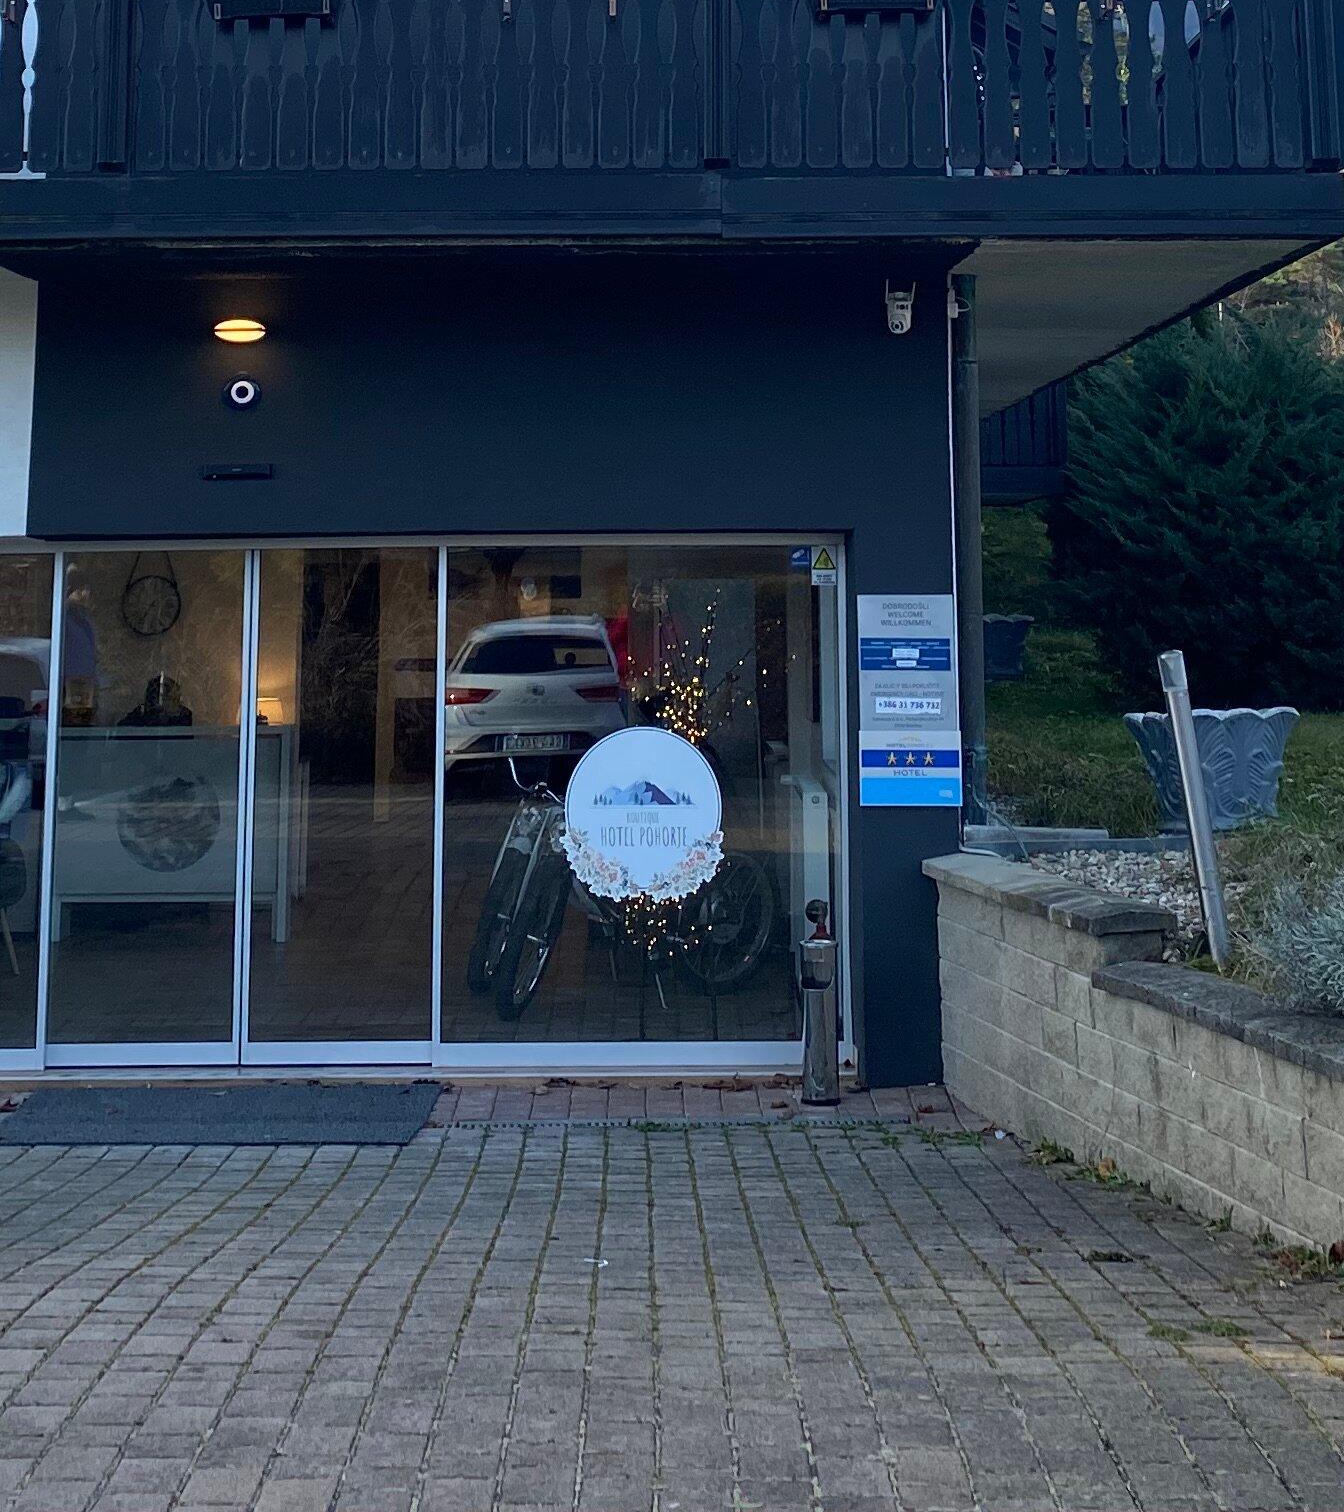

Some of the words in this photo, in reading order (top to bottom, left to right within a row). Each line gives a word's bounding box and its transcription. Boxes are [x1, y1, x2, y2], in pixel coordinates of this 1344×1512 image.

[880, 619, 932, 627] WILLKOMMEN
[893, 769, 928, 777] HOTEL
[600, 826, 635, 847] HOTEL
[639, 826, 688, 848] POHORJE
